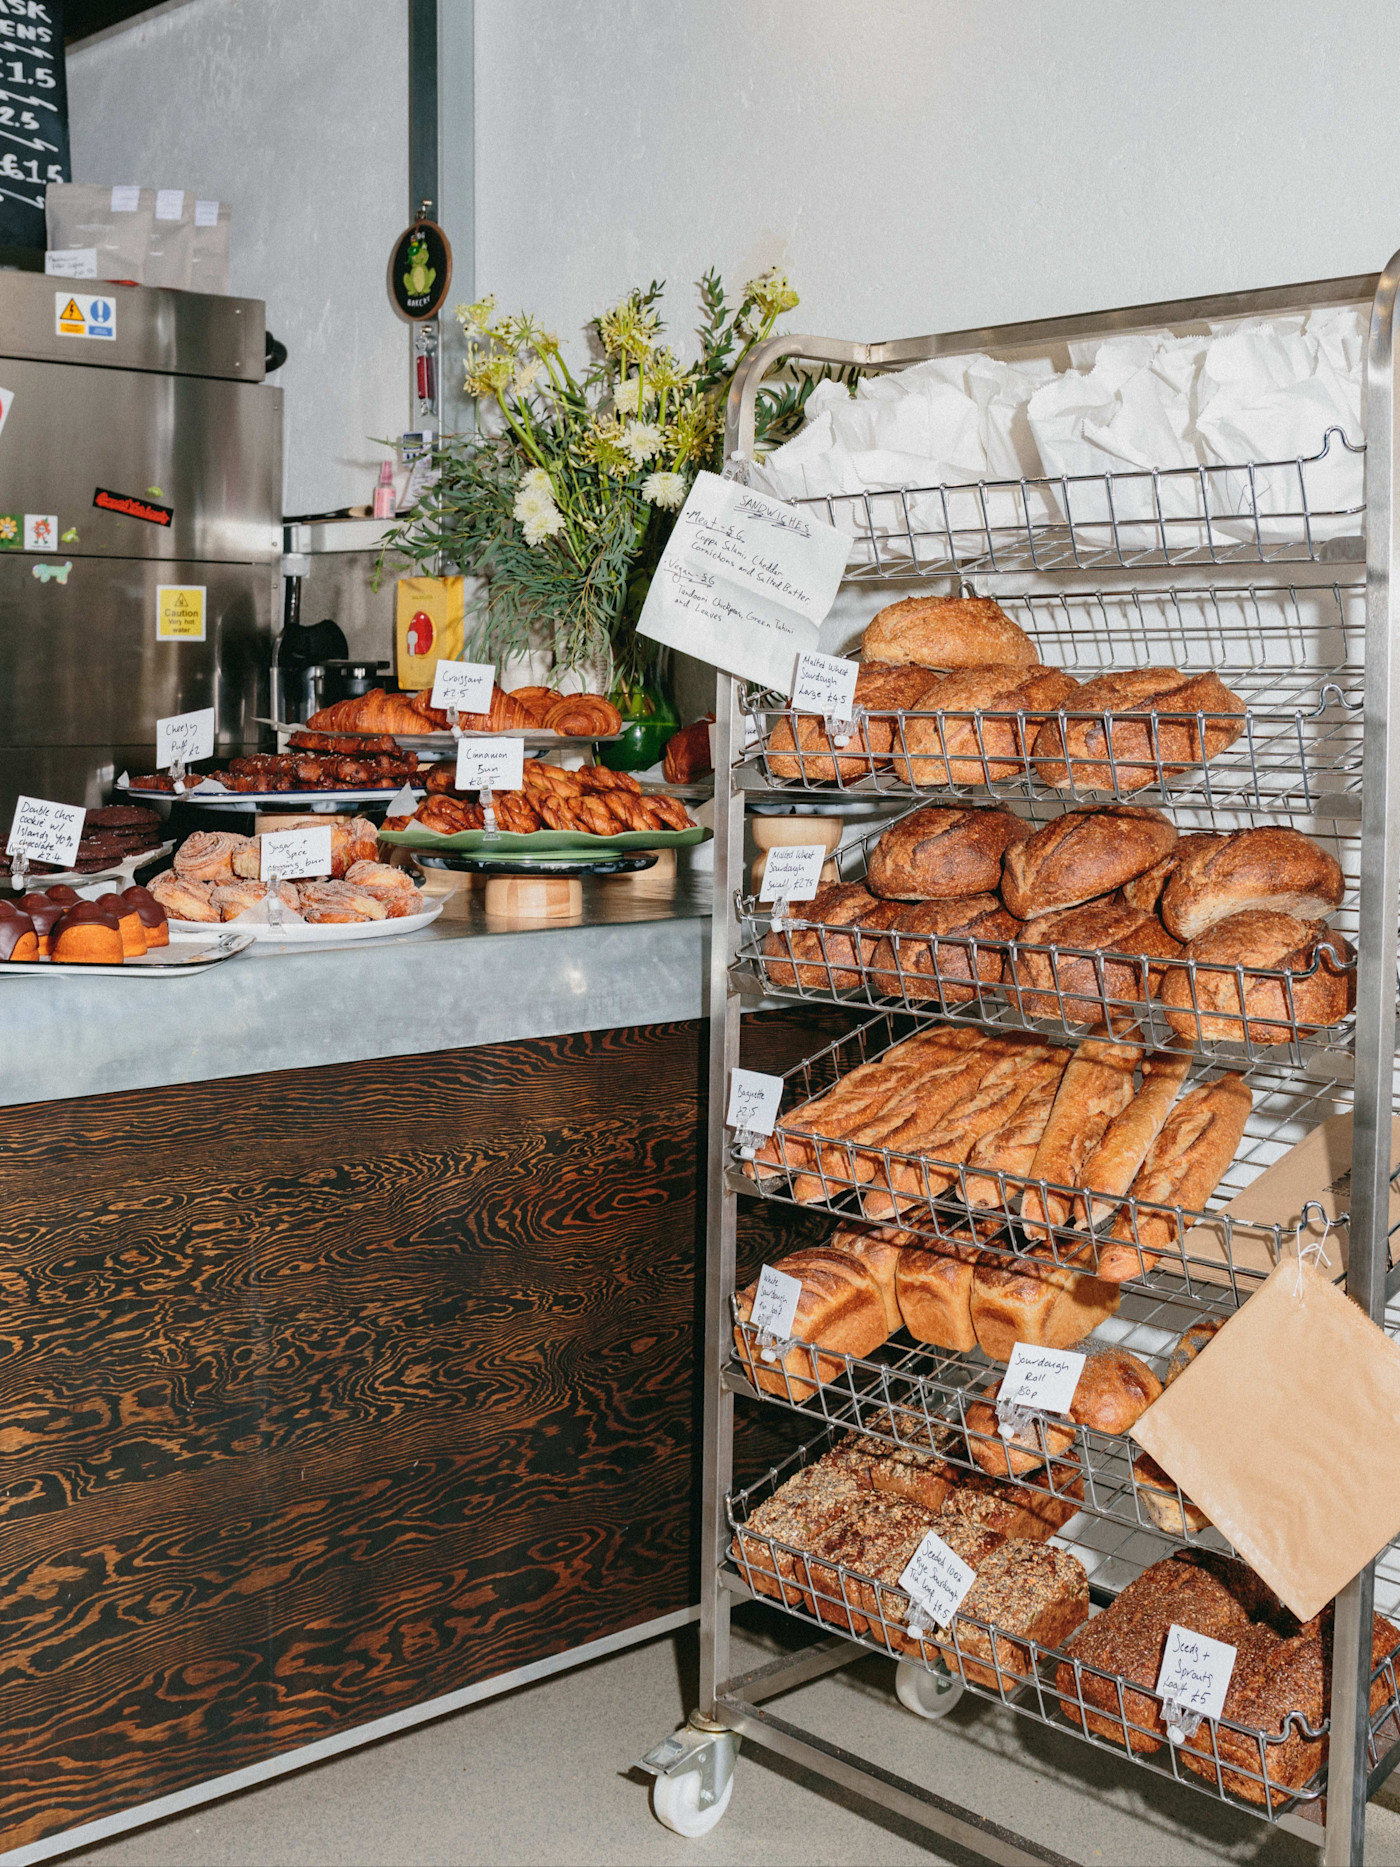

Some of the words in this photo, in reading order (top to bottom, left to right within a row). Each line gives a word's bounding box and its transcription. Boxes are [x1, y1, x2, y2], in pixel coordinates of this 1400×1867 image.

[0, 58, 57, 89] 1.5
[406, 295, 431, 307] BAKERY
[688, 511, 717, 527] Meat
[738, 495, 810, 533] SANDWICHES
[669, 559, 692, 583] Vegan
[691, 541, 735, 567] Cornichons
[738, 564, 752, 576] and
[756, 572, 782, 591] Salted
[164, 608, 199, 618] Caution
[674, 598, 690, 608] and
[695, 603, 722, 622] Leaves
[677, 584, 708, 603] Tandoori
[746, 611, 771, 628] Green
[775, 618, 795, 635] Tahini
[802, 655, 826, 669] Malted
[828, 662, 849, 677] Wheat
[442, 670, 484, 687] Croissant
[800, 666, 837, 688] Sourdough
[798, 684, 822, 700] Large
[166, 723, 198, 737] Cheesy
[188, 743, 200, 757] £2
[466, 748, 508, 760] Cinnamon
[21, 801, 50, 816] Double
[54, 809, 75, 823] Choc
[20, 815, 46, 828] cookie
[268, 841, 294, 854] Sugar
[286, 847, 307, 860] Spice
[772, 849, 794, 860] Malted
[795, 849, 816, 860] Wheat
[305, 858, 325, 867] bun
[768, 861, 805, 877] Sourdough
[737, 1084, 765, 1103] Baguette
[1014, 1352, 1070, 1374] Sourdough
[1024, 1371, 1047, 1382] Roll
[921, 1539, 948, 1569] Seeded
[909, 1567, 920, 1585] Tin
[916, 1556, 928, 1576] Rye
[929, 1567, 959, 1602] Sourdough
[1172, 1633, 1199, 1663] Seeds
[1174, 1658, 1214, 1688] Sprouts
[1190, 1689, 1212, 1705] £5
